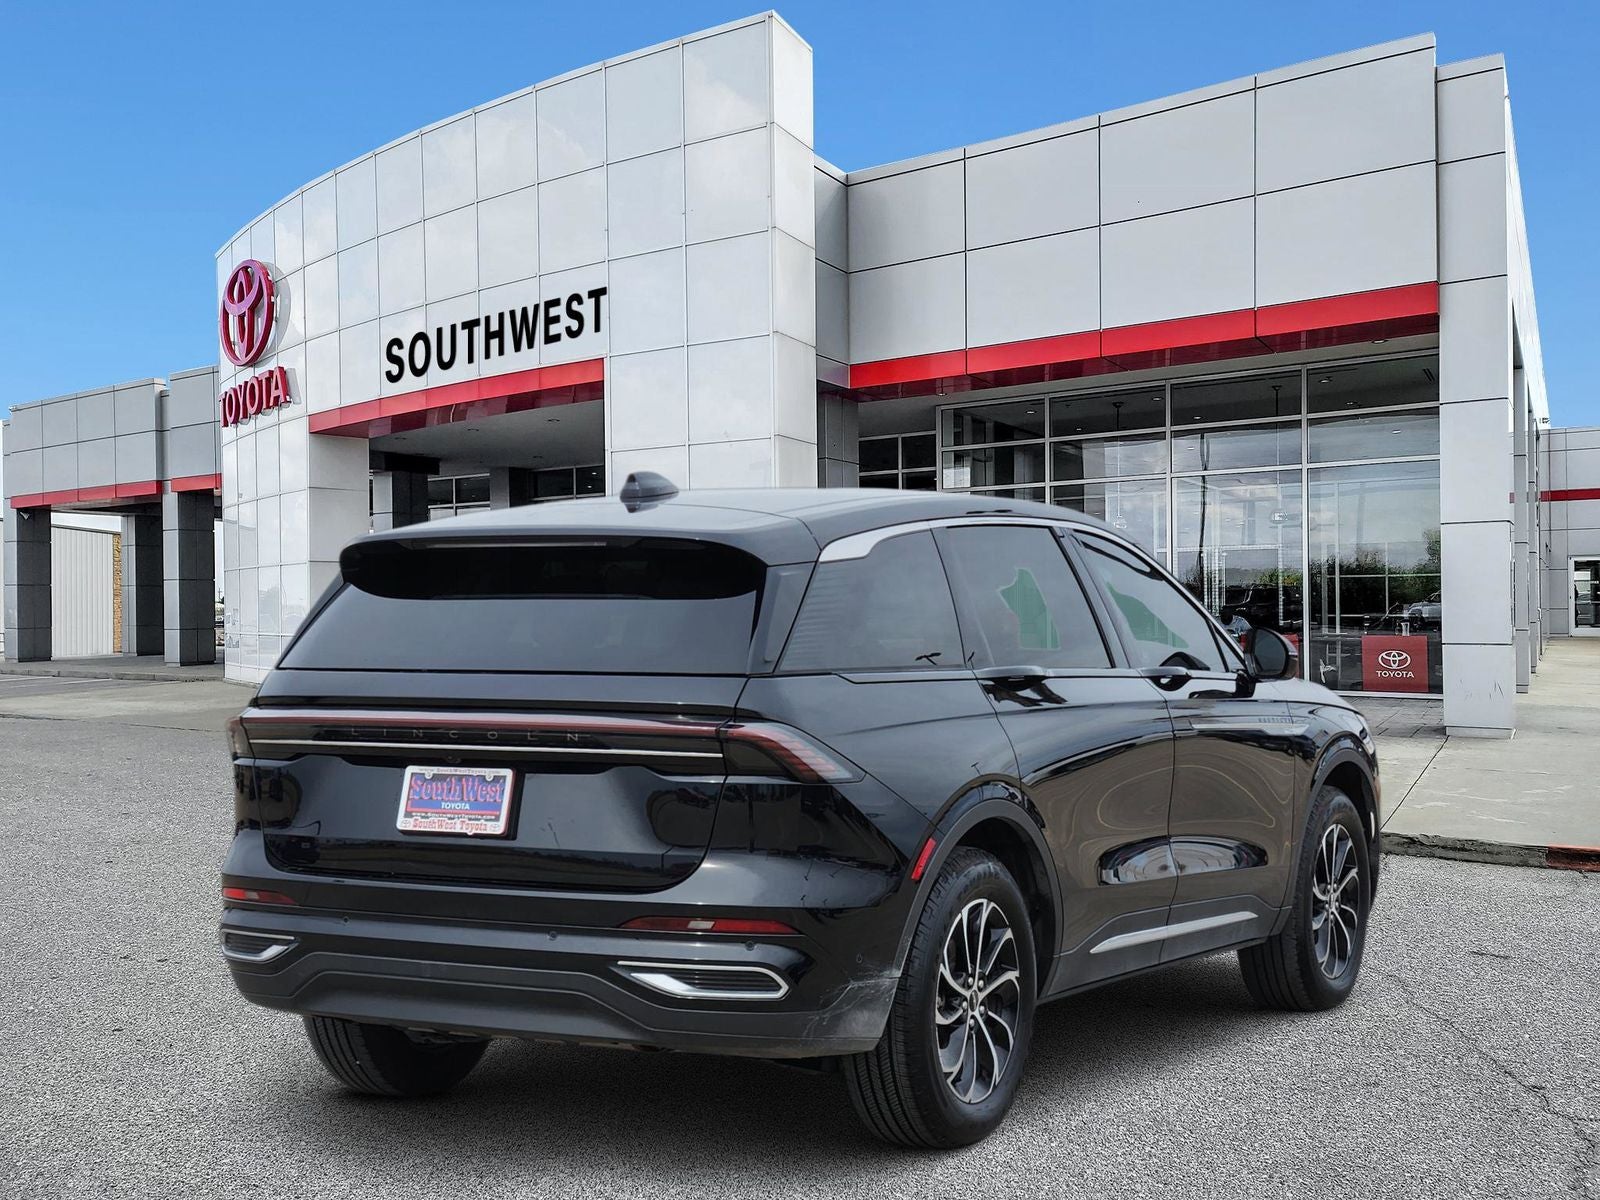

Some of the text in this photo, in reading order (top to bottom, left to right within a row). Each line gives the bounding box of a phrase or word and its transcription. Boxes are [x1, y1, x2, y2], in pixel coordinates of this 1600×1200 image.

[385, 286, 608, 384] SOUTHWEST
[219, 366, 291, 428] TOYOTA
[1376, 670, 1415, 679] TOYOTA
[351, 727, 579, 742] LINCOLN
[409, 773, 506, 803] SouthWest
[441, 801, 470, 810] TOYOTA
[460, 820, 488, 833] Toyota
